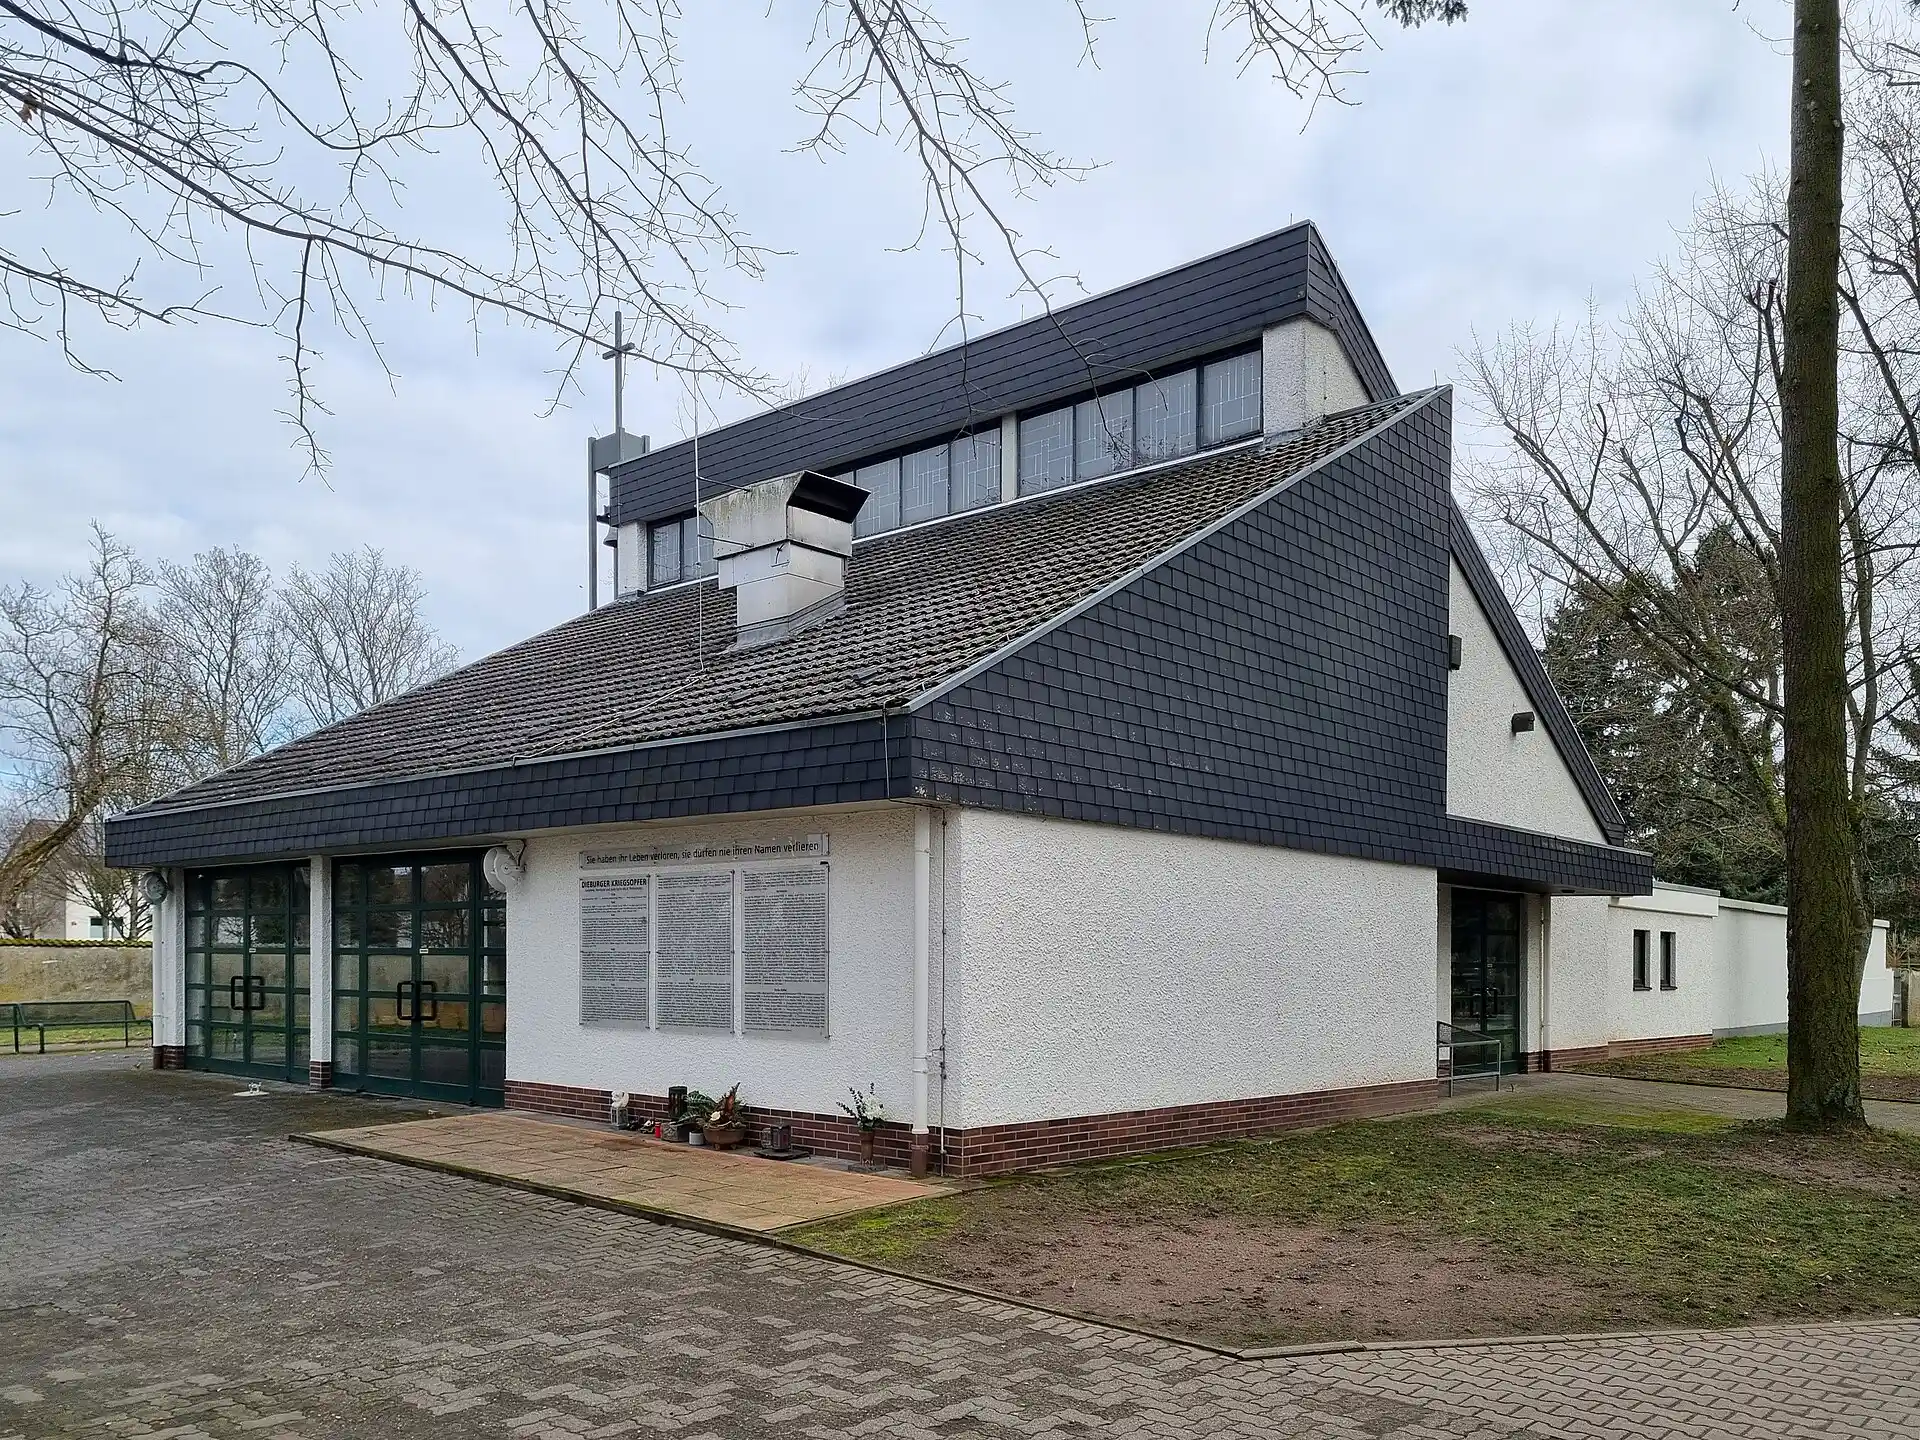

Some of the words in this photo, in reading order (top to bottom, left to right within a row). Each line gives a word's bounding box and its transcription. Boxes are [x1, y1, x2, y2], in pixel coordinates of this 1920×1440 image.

[586, 855, 596, 864] Sie
[597, 854, 617, 863] haben
[618, 853, 628, 862] ihr
[629, 852, 649, 862] Leben
[650, 850, 680, 861] verloren,
[681, 849, 691, 859] sie
[719, 846, 731, 856] nie
[732, 845, 752, 855] ihren
[754, 844, 780, 854] Namen
[783, 842, 819, 853] verlieren
[581, 880, 610, 888] DIEBURGER
[611, 878, 647, 886] KRIEGSOPFER
